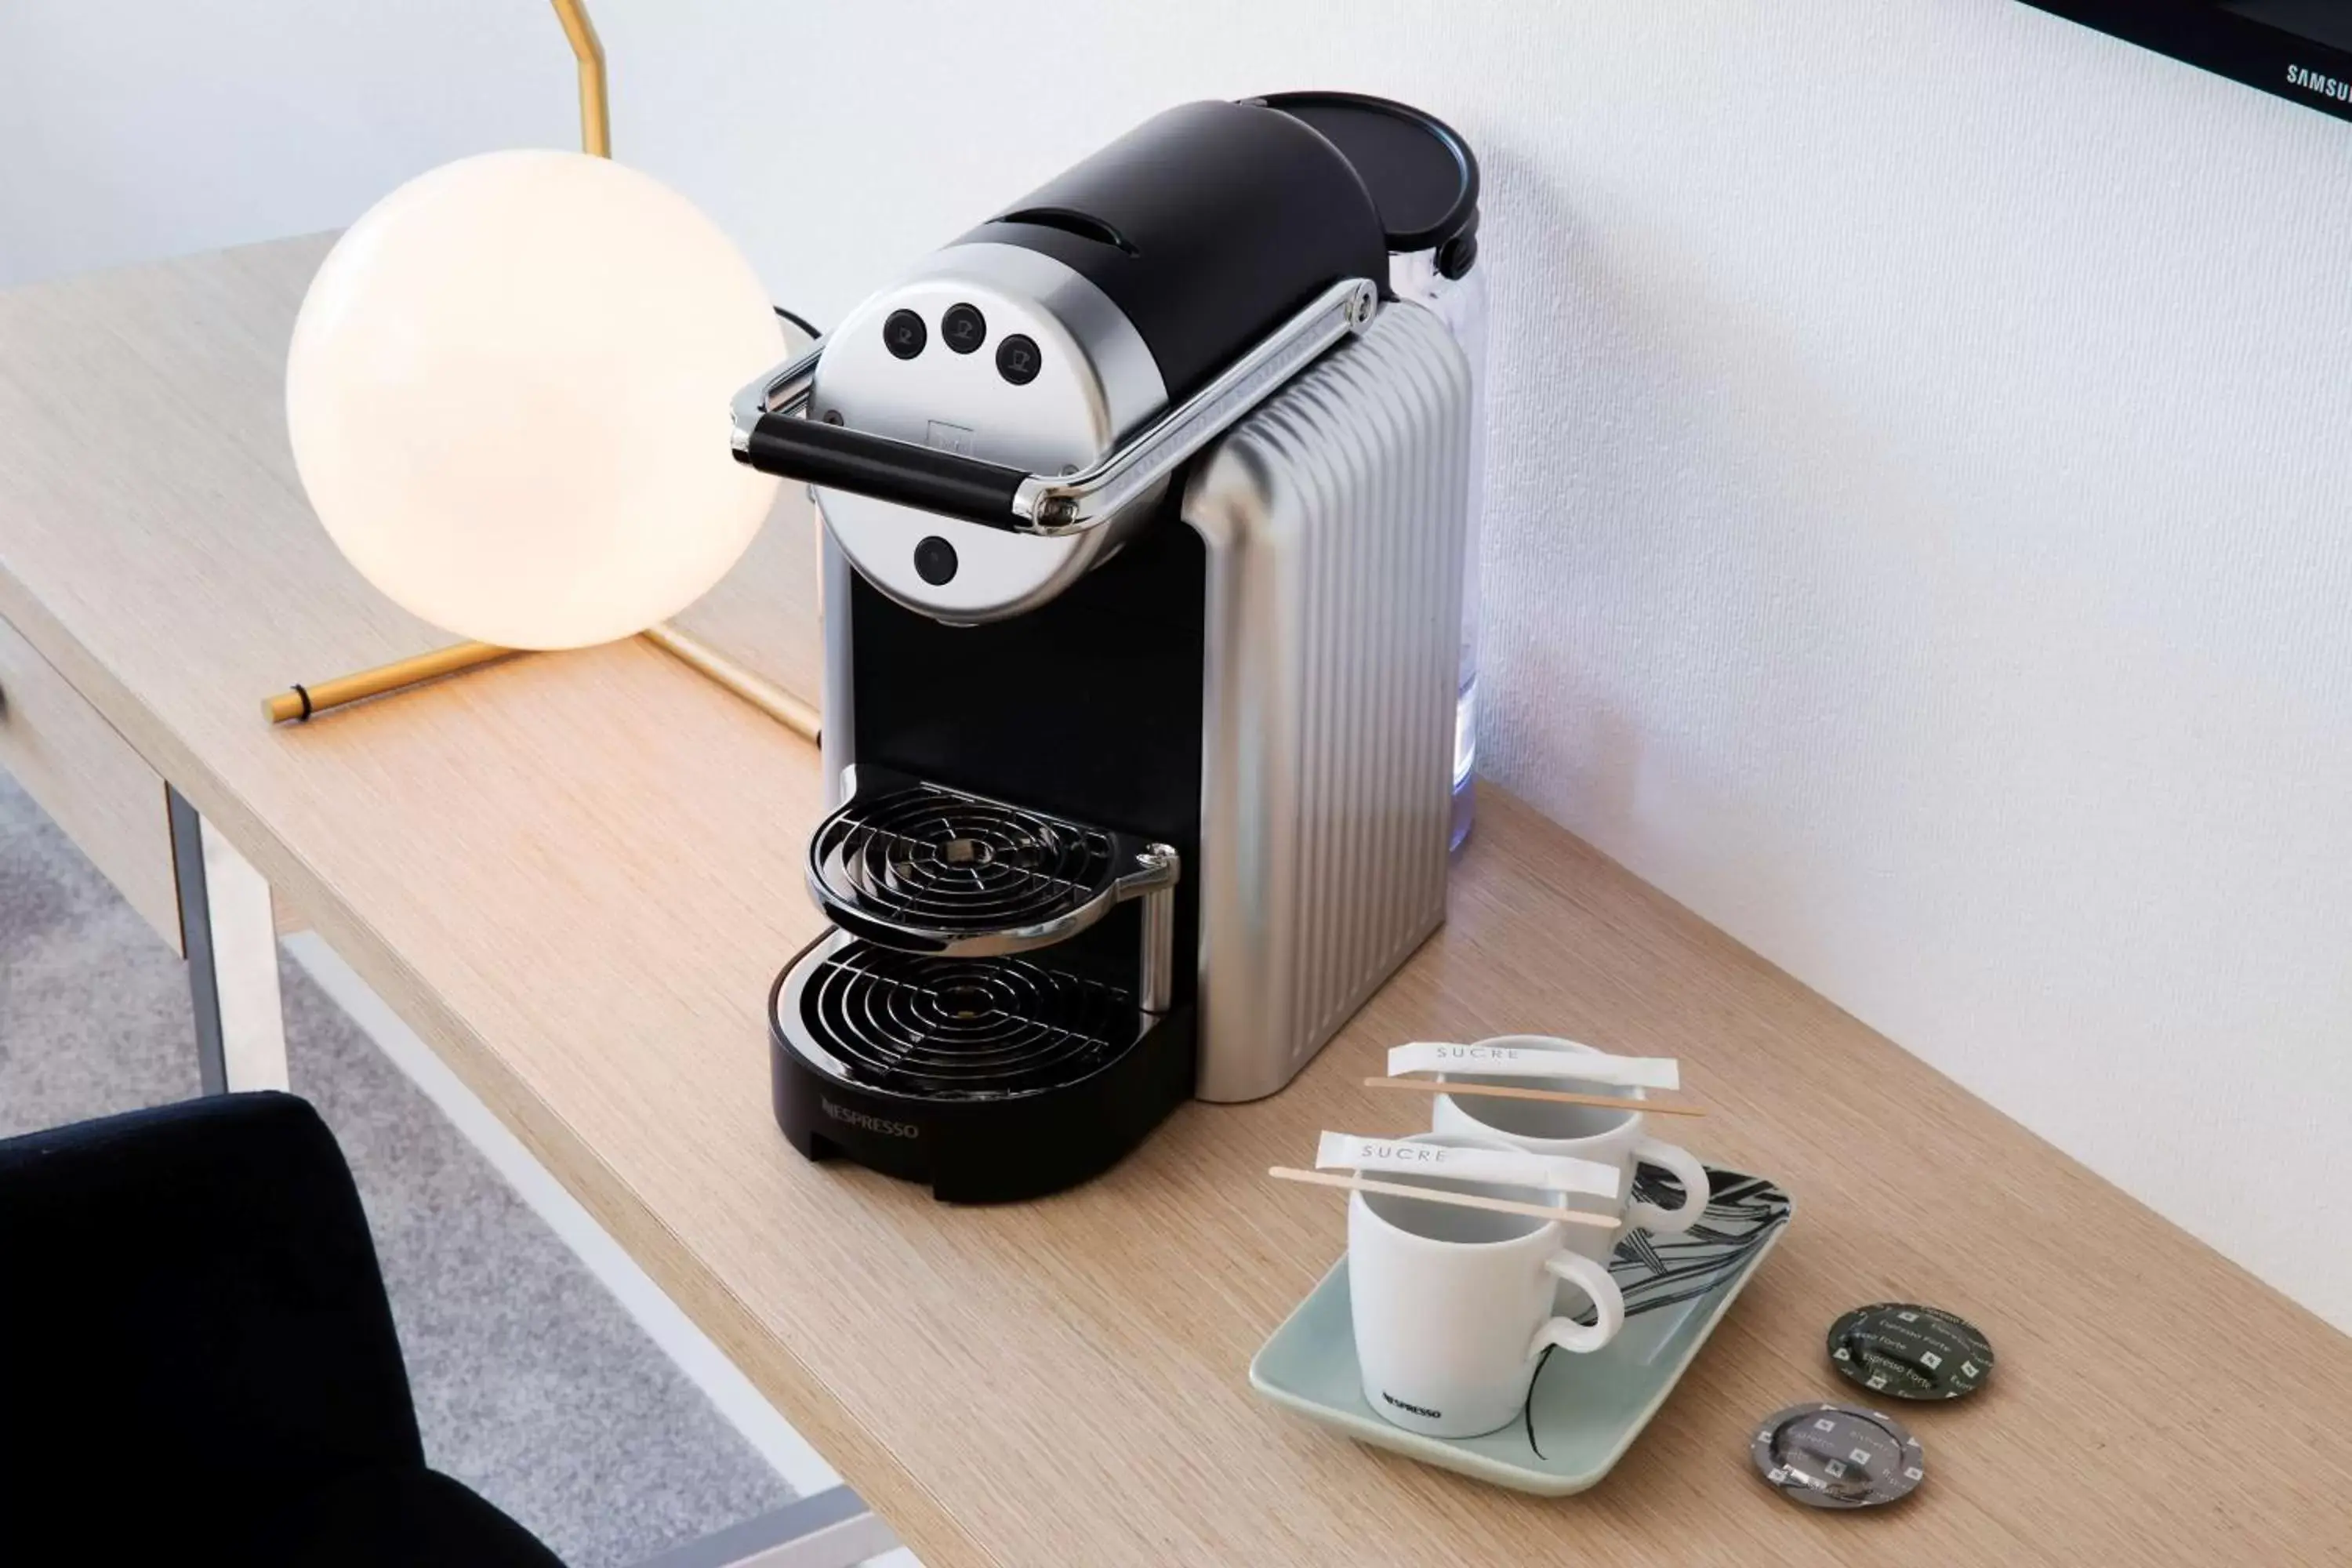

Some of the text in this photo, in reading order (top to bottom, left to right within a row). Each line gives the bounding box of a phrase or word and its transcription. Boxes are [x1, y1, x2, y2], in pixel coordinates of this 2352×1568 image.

[1437, 1047, 1519, 1059] SUCRE
[821, 1095, 919, 1138] NESPRESSO
[1362, 1145, 1446, 1162] SUCRE
[1863, 1352, 1904, 1374] Espresso
[1382, 1392, 1441, 1418] NESPRESSO
